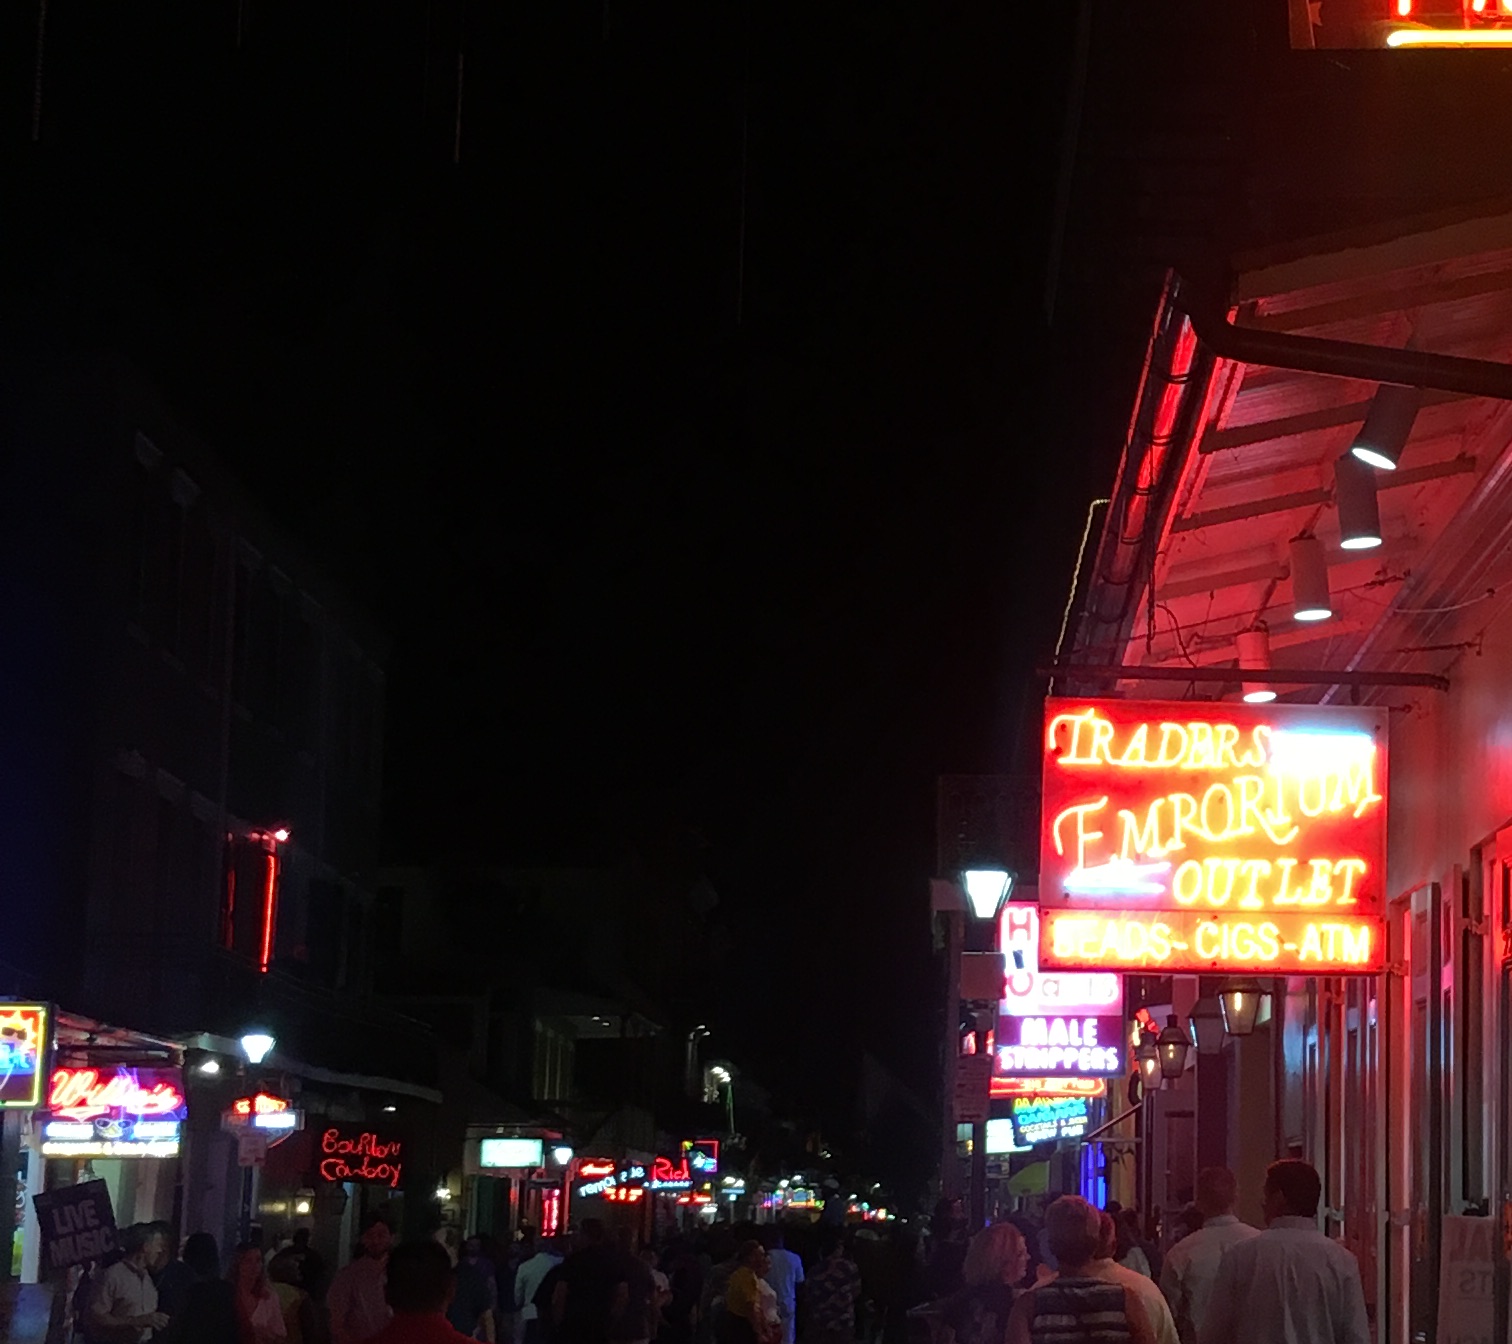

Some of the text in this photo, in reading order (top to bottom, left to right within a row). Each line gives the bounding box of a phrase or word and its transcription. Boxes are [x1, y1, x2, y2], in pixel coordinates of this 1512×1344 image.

[1049, 708, 1275, 769] TRADERS
[1052, 748, 1383, 869] EMPORIUM
[1172, 857, 1367, 909] OUTLET
[1020, 1017, 1098, 1047] MALE
[999, 1046, 1120, 1071] STRIPPERS
[51, 1199, 101, 1236] LIVE
[48, 1225, 116, 1268] MUSIC
